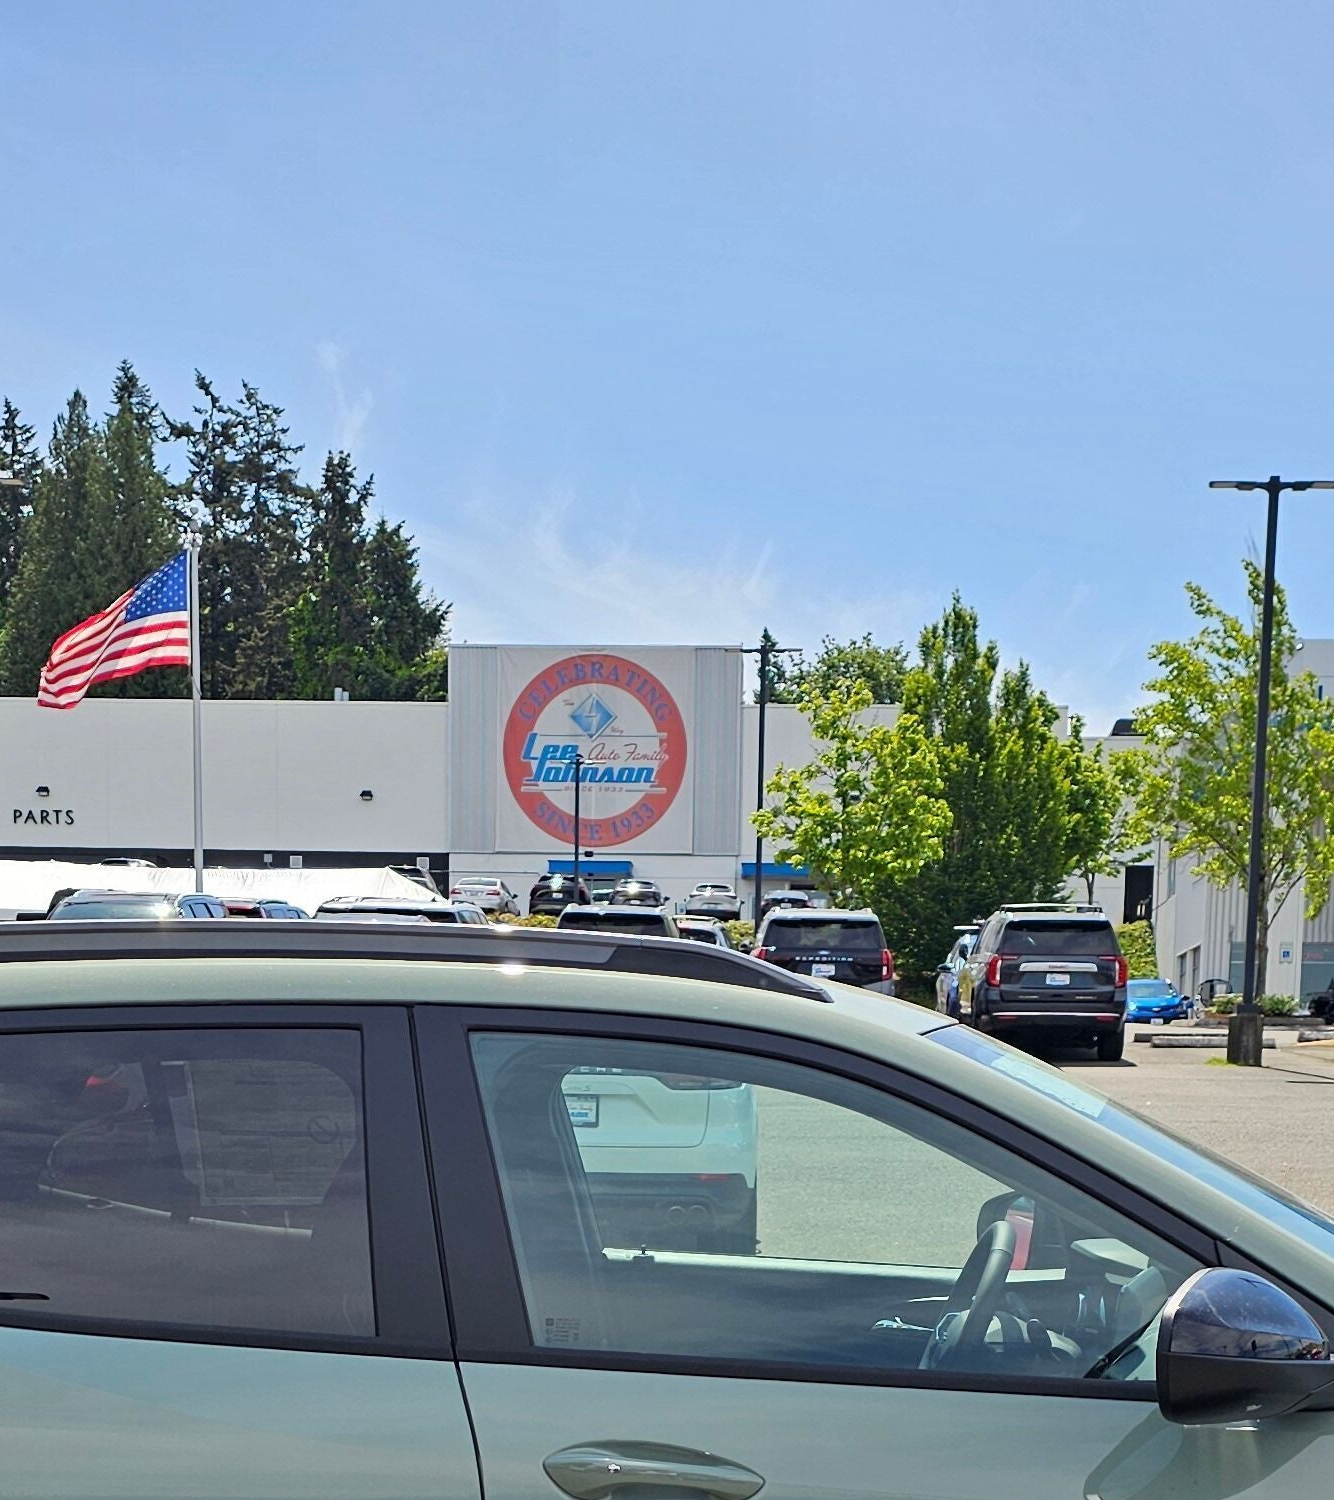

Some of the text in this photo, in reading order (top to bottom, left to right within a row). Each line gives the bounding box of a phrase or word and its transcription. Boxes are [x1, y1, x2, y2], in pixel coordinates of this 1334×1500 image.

[519, 661, 673, 722] CELEBRATING
[522, 732, 668, 767] Lee Auto Family
[524, 757, 657, 783] Johnson
[13, 809, 75, 825] PARTS
[535, 802, 655, 841] SINCE 1933
